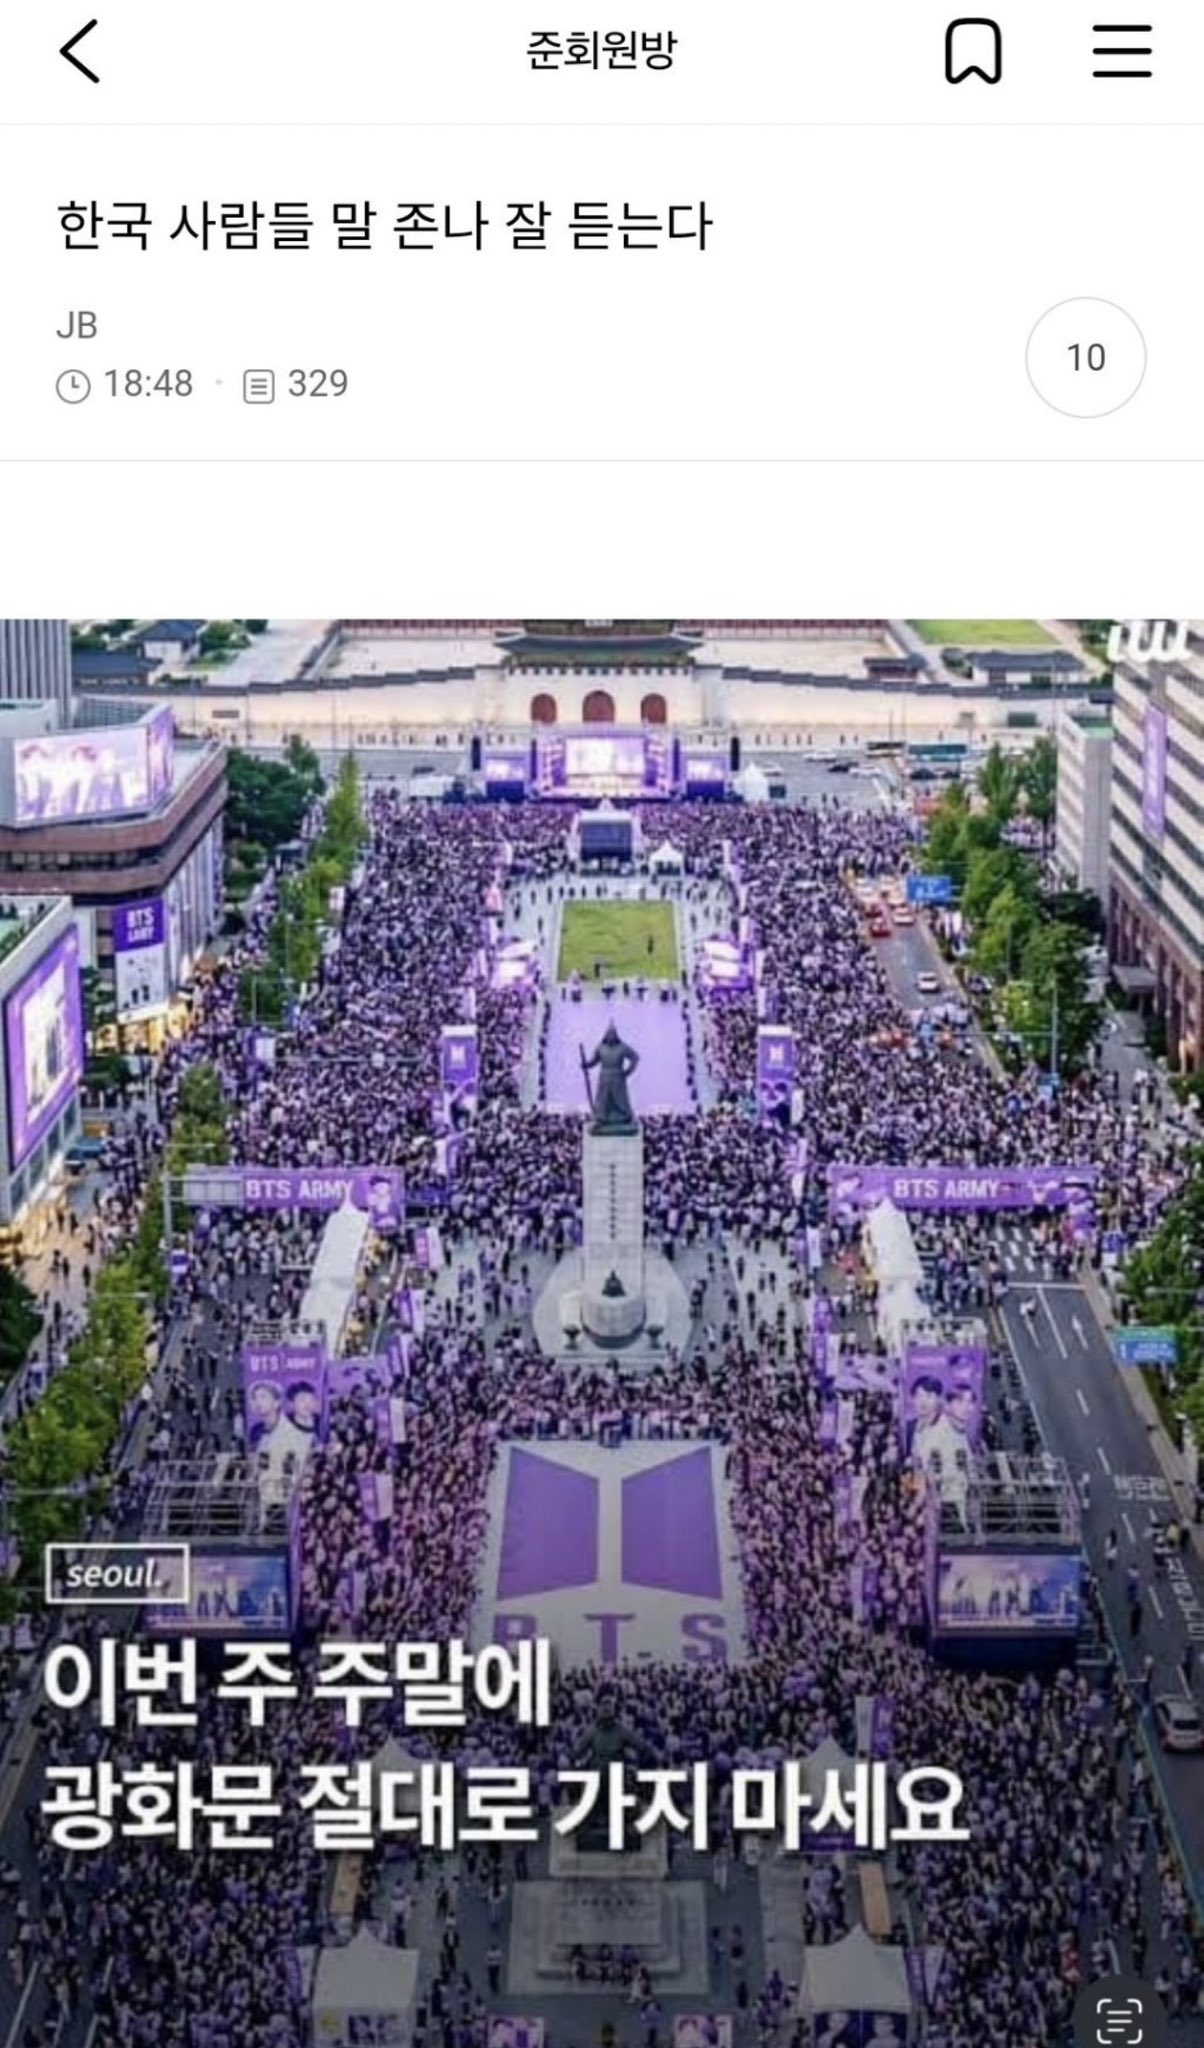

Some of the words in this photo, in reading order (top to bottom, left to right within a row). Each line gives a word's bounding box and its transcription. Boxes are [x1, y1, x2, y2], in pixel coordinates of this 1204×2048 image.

[246, 1179, 291, 1200] BTS
[300, 1178, 354, 1201] ARMY
[894, 1179, 938, 1198] BTS
[944, 1179, 999, 1199] ARMY
